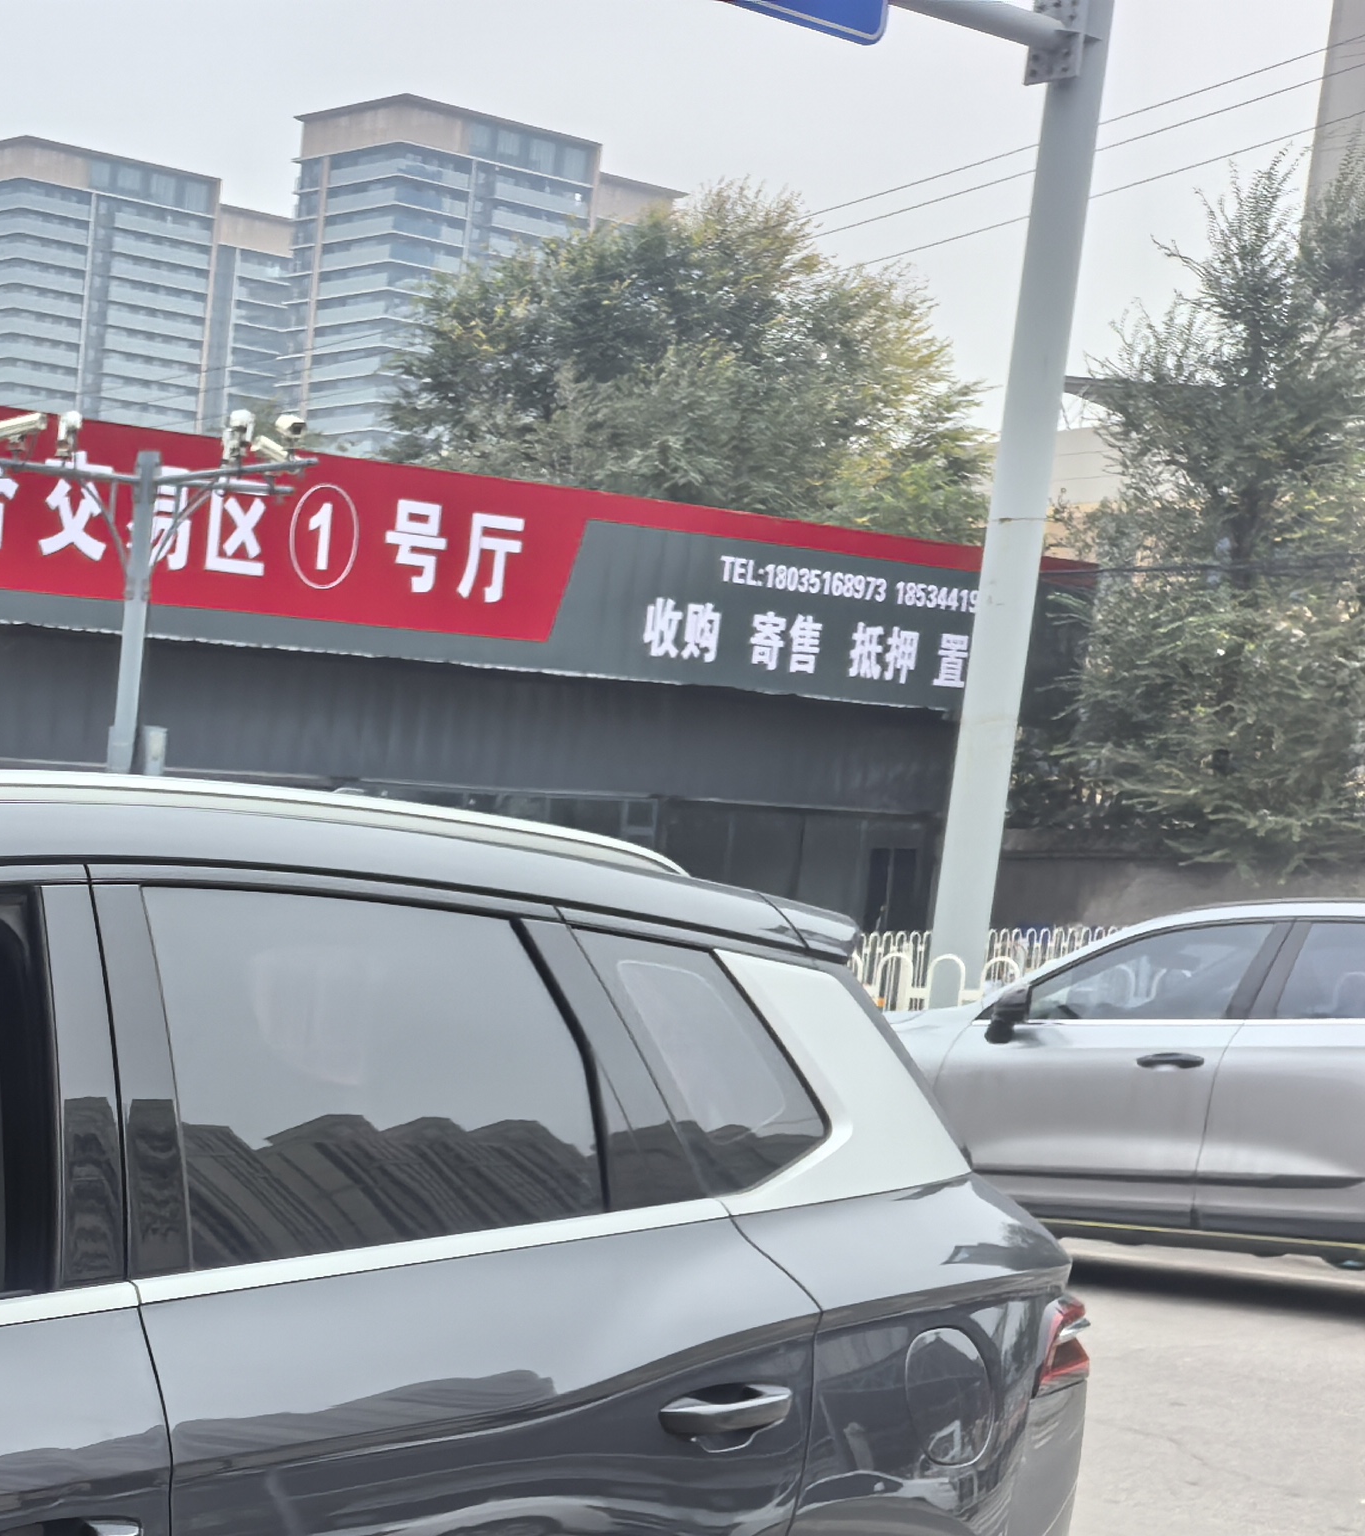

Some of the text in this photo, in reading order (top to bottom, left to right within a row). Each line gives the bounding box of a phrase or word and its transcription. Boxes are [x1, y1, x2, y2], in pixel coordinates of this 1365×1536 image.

[720, 555, 980, 614] TEL:18035168973 18534419
[643, 597, 722, 664] 收购
[749, 611, 823, 675] 寄售
[846, 621, 920, 685] 抵押
